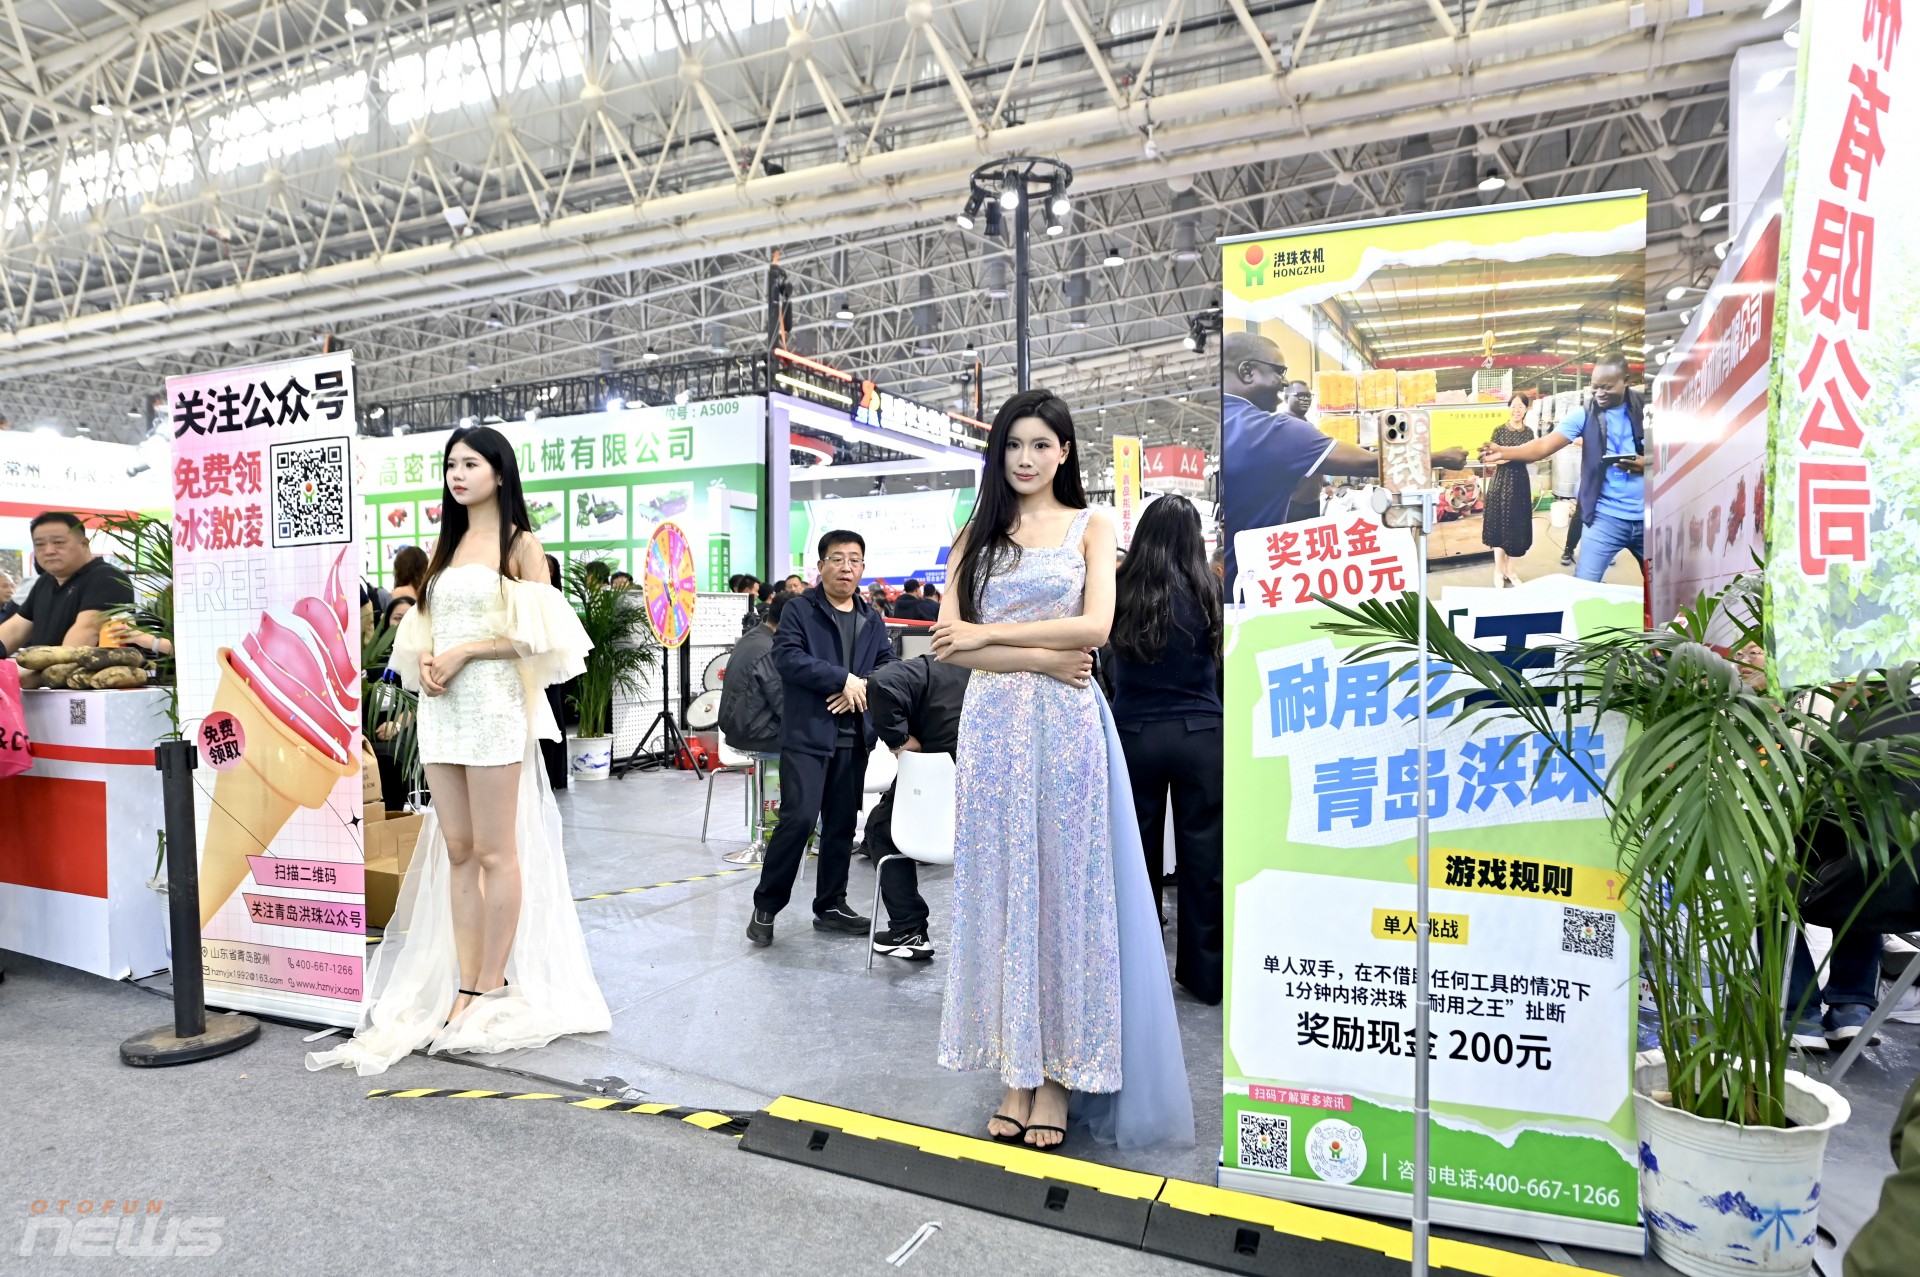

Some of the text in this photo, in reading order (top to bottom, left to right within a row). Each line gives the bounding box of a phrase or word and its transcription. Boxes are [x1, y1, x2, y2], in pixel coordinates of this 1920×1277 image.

[1274, 248, 1325, 267] 洪珠农机
[1274, 265, 1325, 278] HONGZHU
[174, 370, 349, 439] 关注公众号
[174, 451, 263, 500] 免费领
[1180, 453, 1198, 475] A4
[175, 503, 264, 552] 冰激凌
[1266, 517, 1381, 570] 奖现金
[175, 558, 269, 612] FREE
[203, 719, 236, 746] 免费
[209, 740, 241, 765] 领取
[1314, 726, 1608, 832] 青岛洪珠
[274, 863, 337, 885] 扫描二维码
[1445, 855, 1574, 897] 游戏规则
[252, 900, 362, 929] 关注青岛洪珠公众号
[210, 947, 270, 966] 山东省青岛胶州
[295, 959, 353, 976] 400-667-1266
[211, 967, 284, 985] hznyjx1992@163.com
[296, 980, 360, 996] www.hznyjx.com
[1449, 1030, 1551, 1070] 200元
[1255, 1087, 1345, 1109] 扫码了解更多资讯
